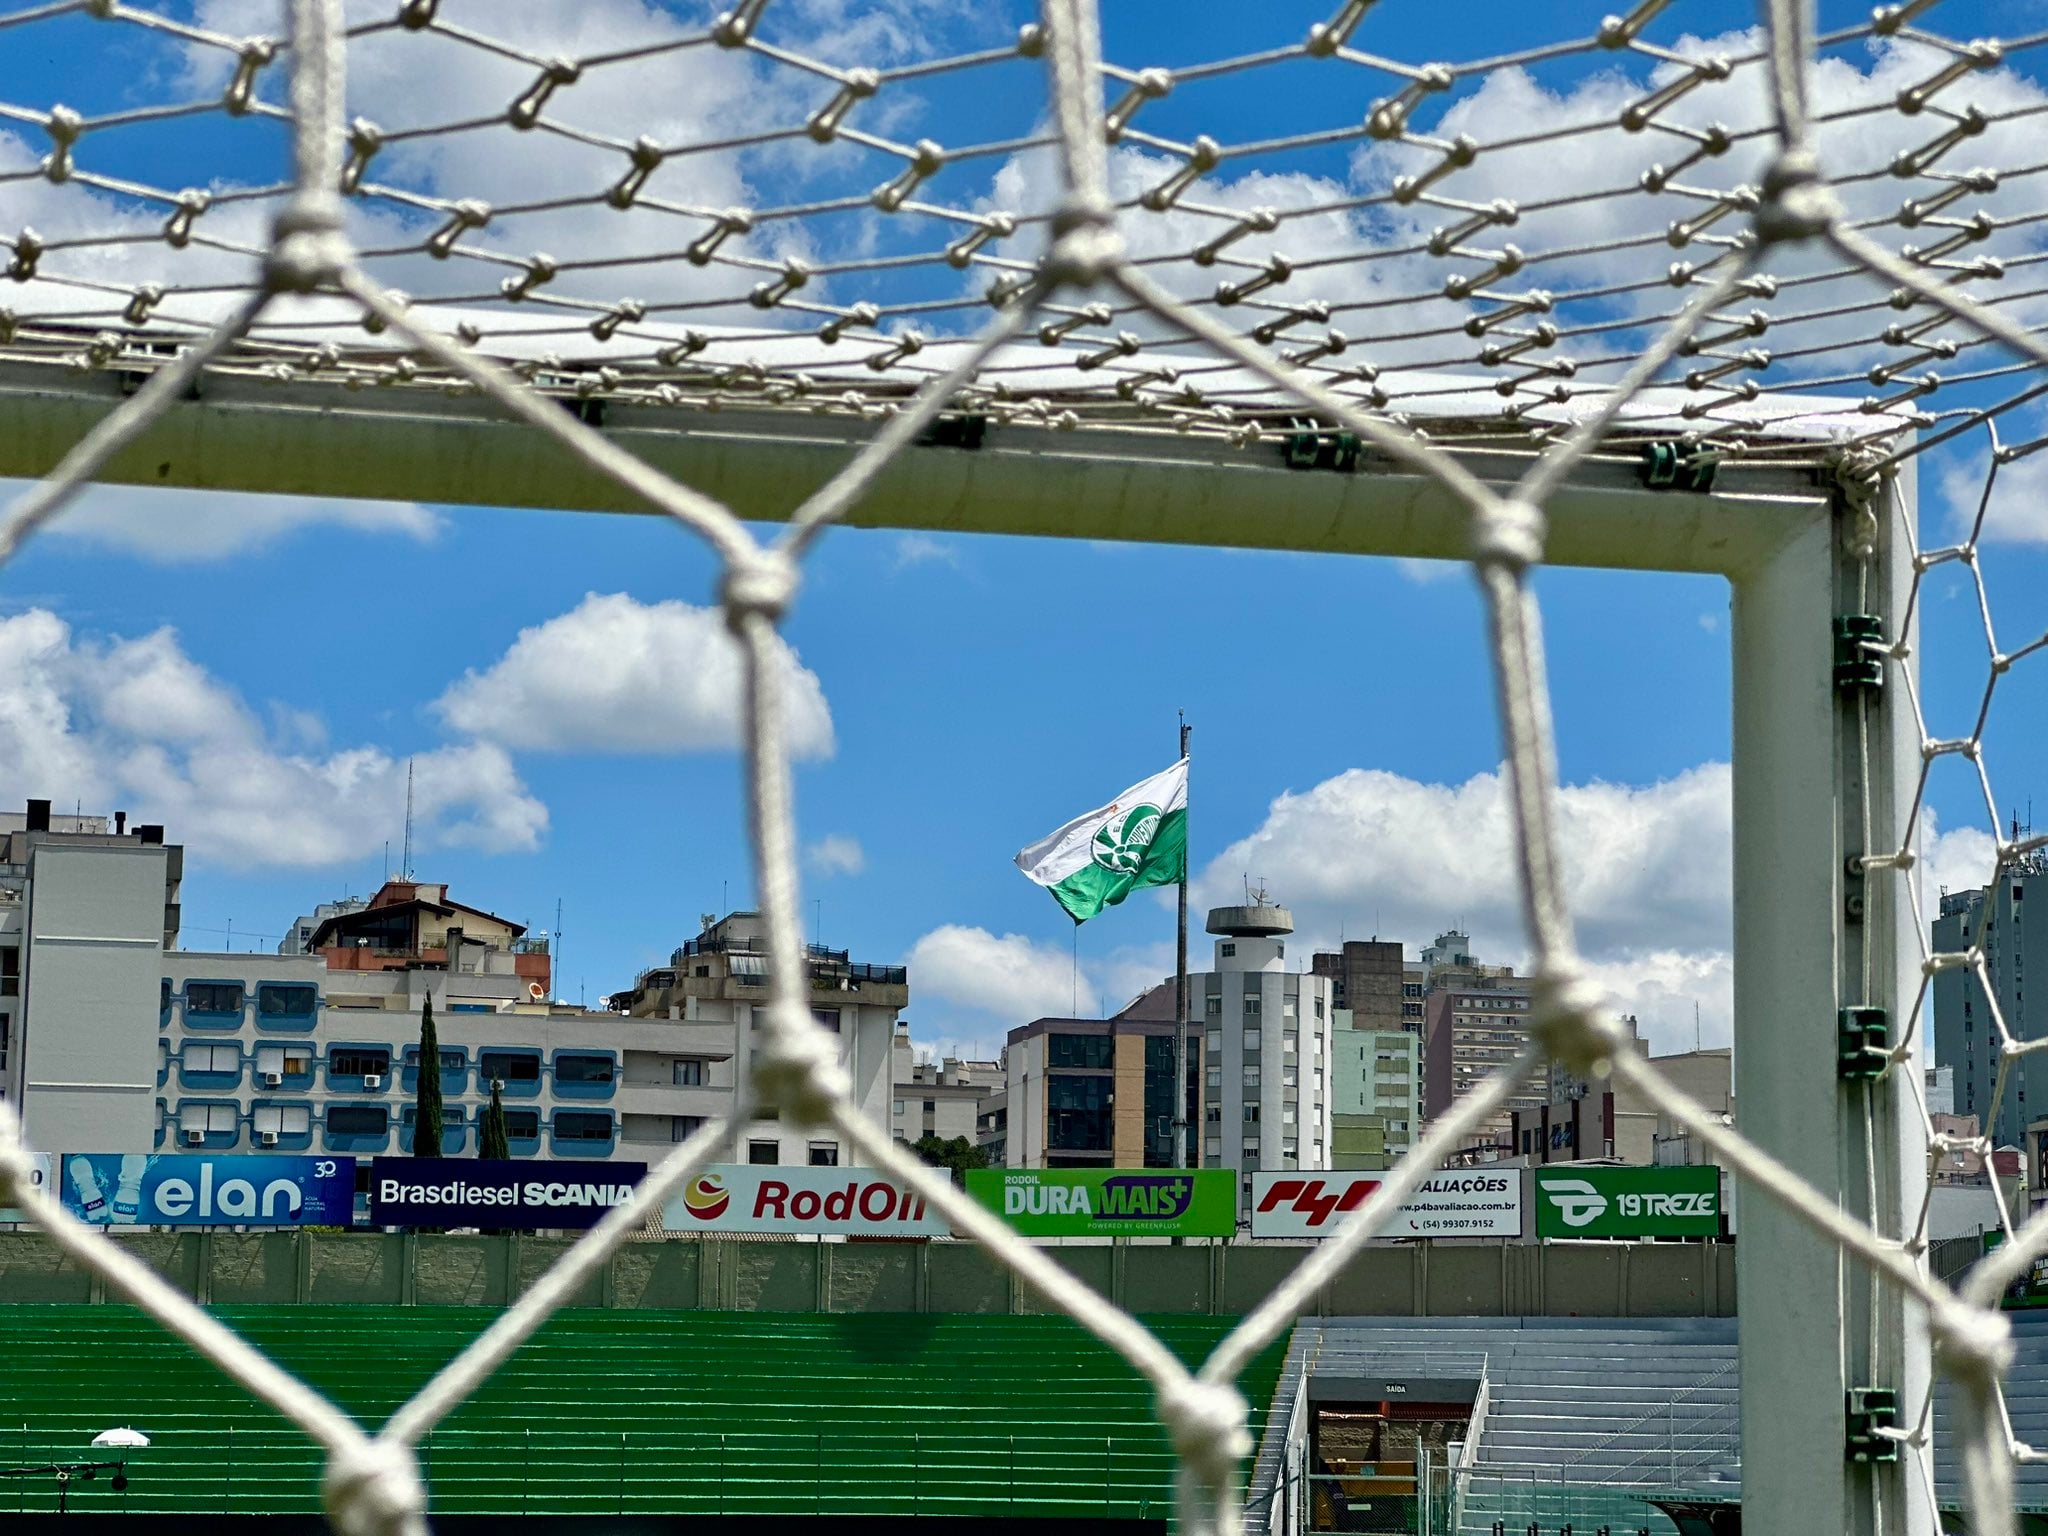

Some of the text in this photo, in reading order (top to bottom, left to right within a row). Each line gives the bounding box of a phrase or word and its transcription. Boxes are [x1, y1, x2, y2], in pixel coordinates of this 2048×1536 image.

[314, 1160, 336, 1178] 30
[1004, 1175, 1040, 1185] RODOIL
[154, 1162, 302, 1217] elan
[380, 1179, 636, 1207] Brasdiesel SCANIA
[1004, 1185, 1092, 1215] DURA
[1396, 1202, 1516, 1212] ww.p4bavaliacao.com.br
[1422, 1220, 1494, 1231] (54) 99307.9152
